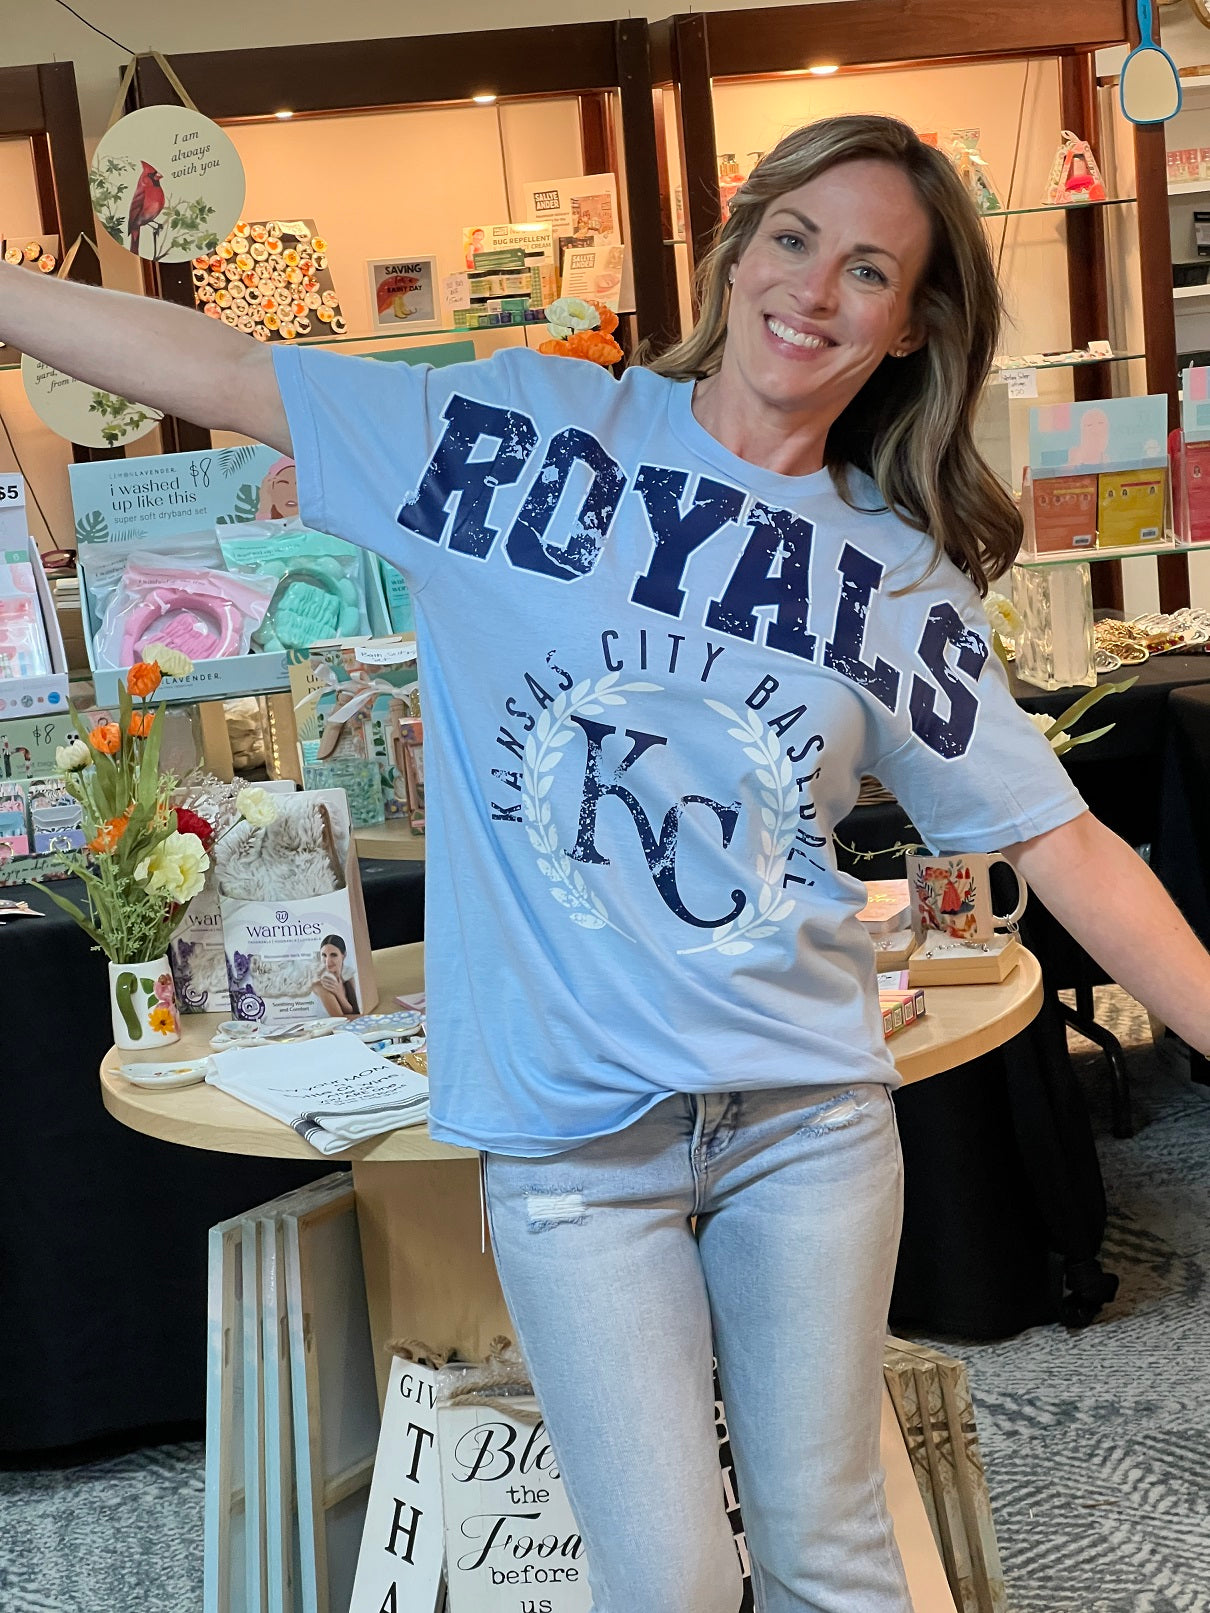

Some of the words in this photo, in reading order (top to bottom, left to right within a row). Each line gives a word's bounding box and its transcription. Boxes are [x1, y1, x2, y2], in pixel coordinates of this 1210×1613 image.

[173, 133, 179, 145] I
[182, 131, 199, 142] am
[171, 144, 211, 162] always
[171, 162, 197, 179] with
[199, 159, 220, 177] you
[535, 191, 559, 202] SALLYE
[536, 199, 560, 210] ANDER
[509, 235, 551, 244] REPELLENT
[385, 263, 422, 275] SAVING
[189, 457, 212, 488] $8
[110, 483, 114, 496] i
[119, 476, 180, 495] washed
[112, 500, 133, 513] up
[137, 494, 164, 508] like
[169, 490, 197, 505] this
[114, 515, 137, 524] super
[140, 512, 156, 521] soft
[158, 508, 192, 519] dryband
[194, 507, 208, 515] set
[396, 392, 990, 762] ROYALS
[33, 723, 55, 746] $8
[491, 649, 574, 823] KANSAS
[601, 629, 725, 683] CITY
[564, 715, 747, 928] KC
[188, 913, 222, 926] war
[246, 920, 322, 938] warmies
[344, 1065, 390, 1082] MOM
[400, 1374, 438, 1410] GIV
[506, 1486, 550, 1504] the
[491, 1565, 579, 1584] before
